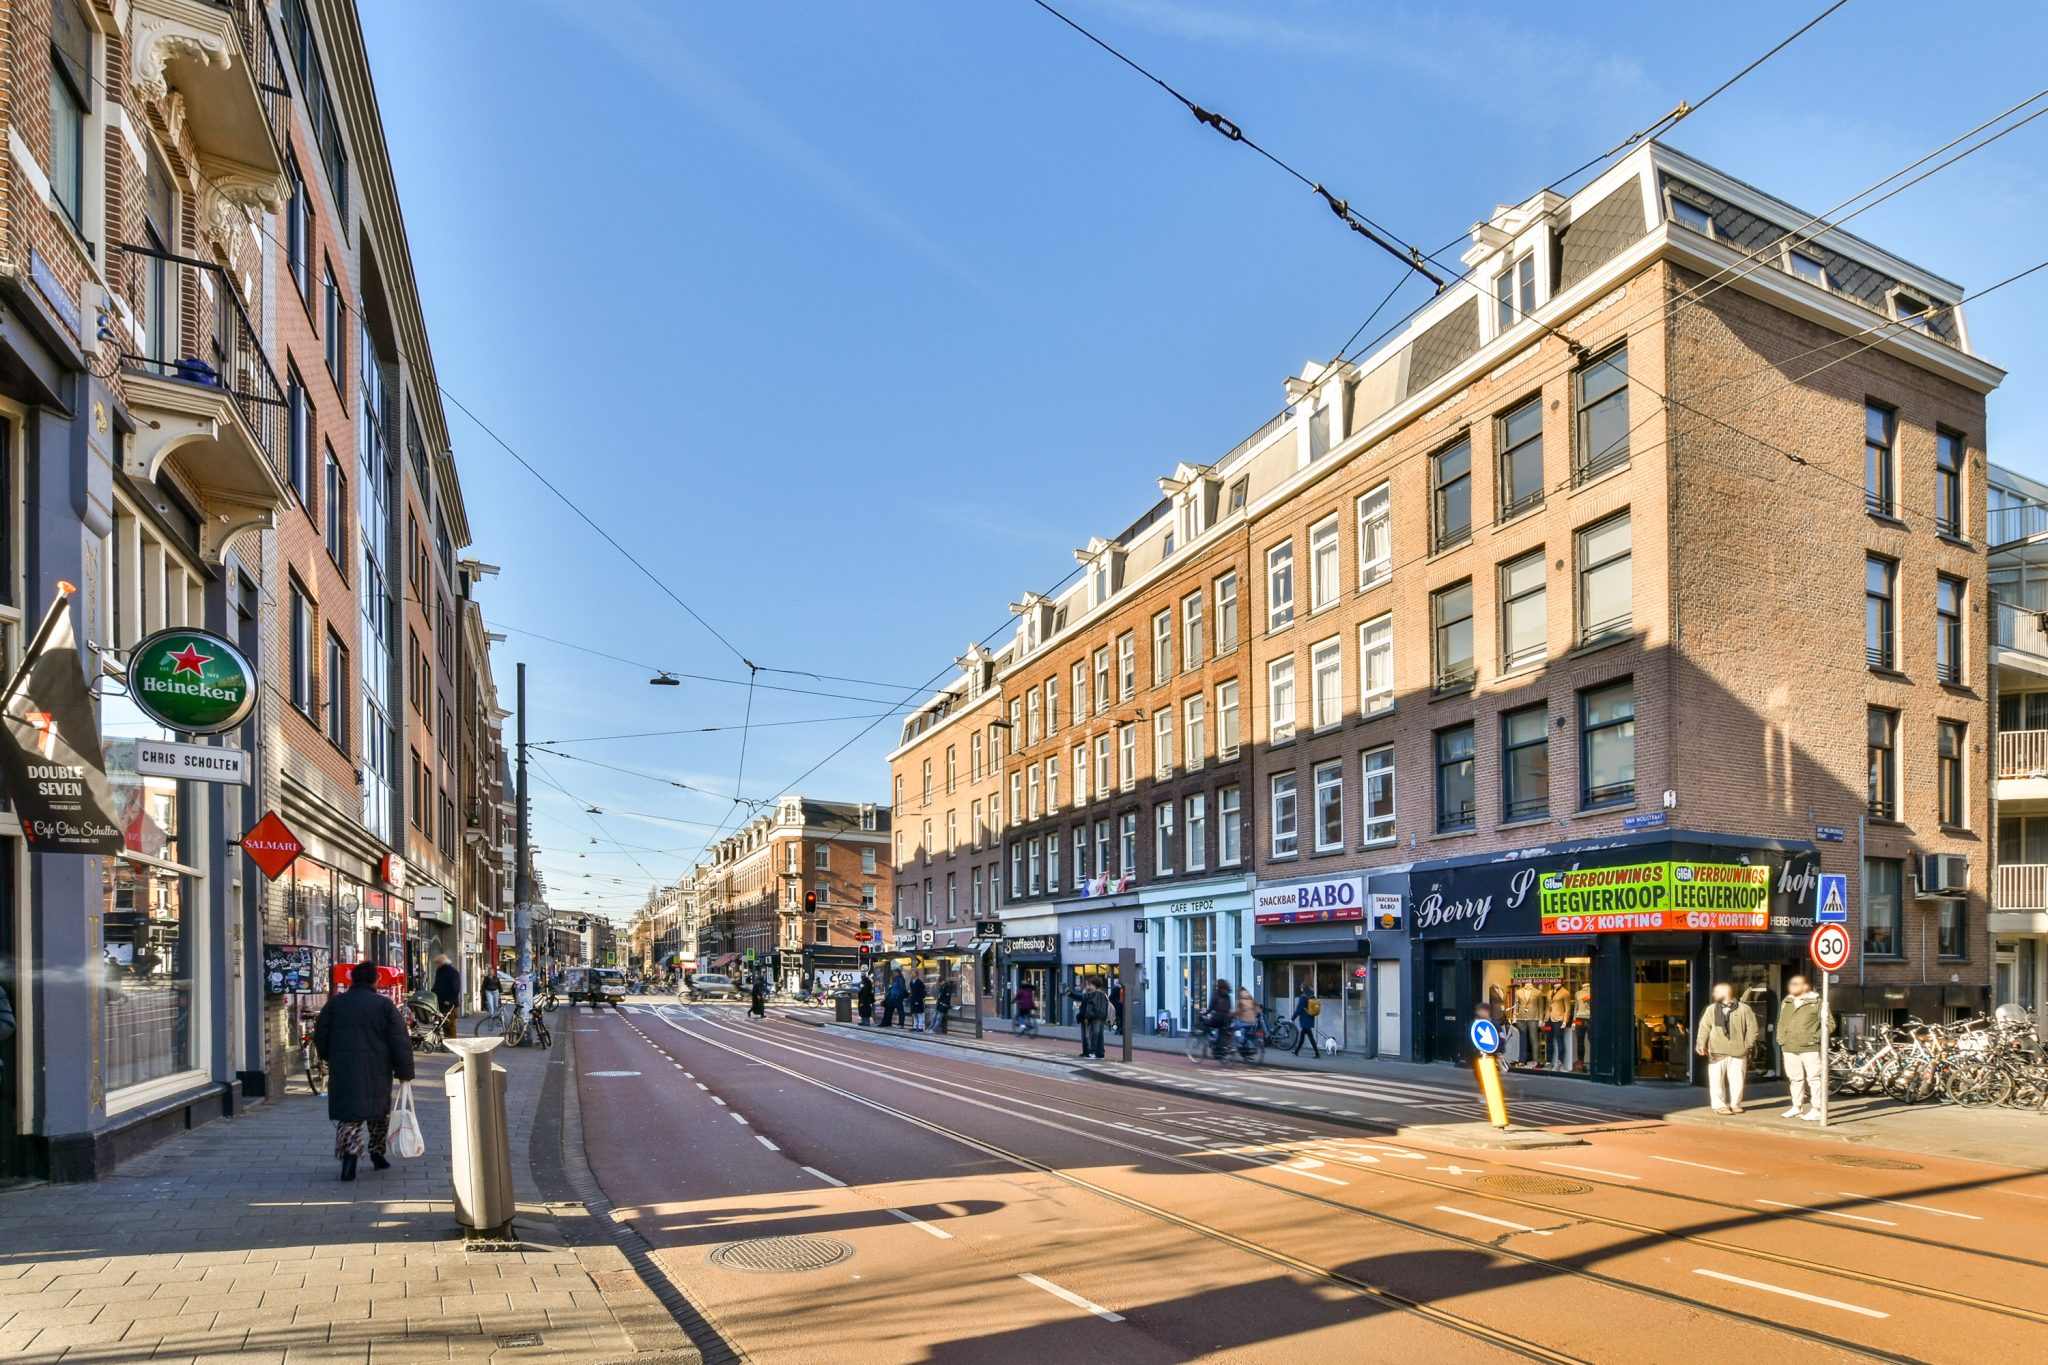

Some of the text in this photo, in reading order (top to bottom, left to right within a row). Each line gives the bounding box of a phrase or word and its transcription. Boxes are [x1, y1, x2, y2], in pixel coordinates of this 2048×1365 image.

[143, 676, 237, 702] Heineken
[142, 750, 239, 771] CHRIS SCHOLTEN
[27, 765, 84, 780] DOUBLE
[38, 782, 82, 796] SEVEN
[56, 821, 80, 836] Chris
[81, 821, 119, 837] Scholten
[244, 839, 297, 851] SALMARI
[1564, 865, 1664, 889] VERBOUWINGS
[1675, 866, 1765, 885] GIGA VERBOUWINGS
[1259, 882, 1355, 908] SNACKBAR BABO
[1543, 885, 1666, 914] LEEGVERKOOP
[1674, 884, 1767, 909] LEEGVERKOOP
[1170, 900, 1214, 914] CAFE TEPOZ
[1417, 893, 1493, 931] Berry
[1544, 920, 1556, 930] TOT
[1597, 912, 1663, 930] KORTING
[1675, 911, 1764, 928] TOT 60% KORTING
[1770, 916, 1814, 928] HERENMODE
[1012, 938, 1045, 952] coffeeshop
[1821, 938, 1843, 955] 30
